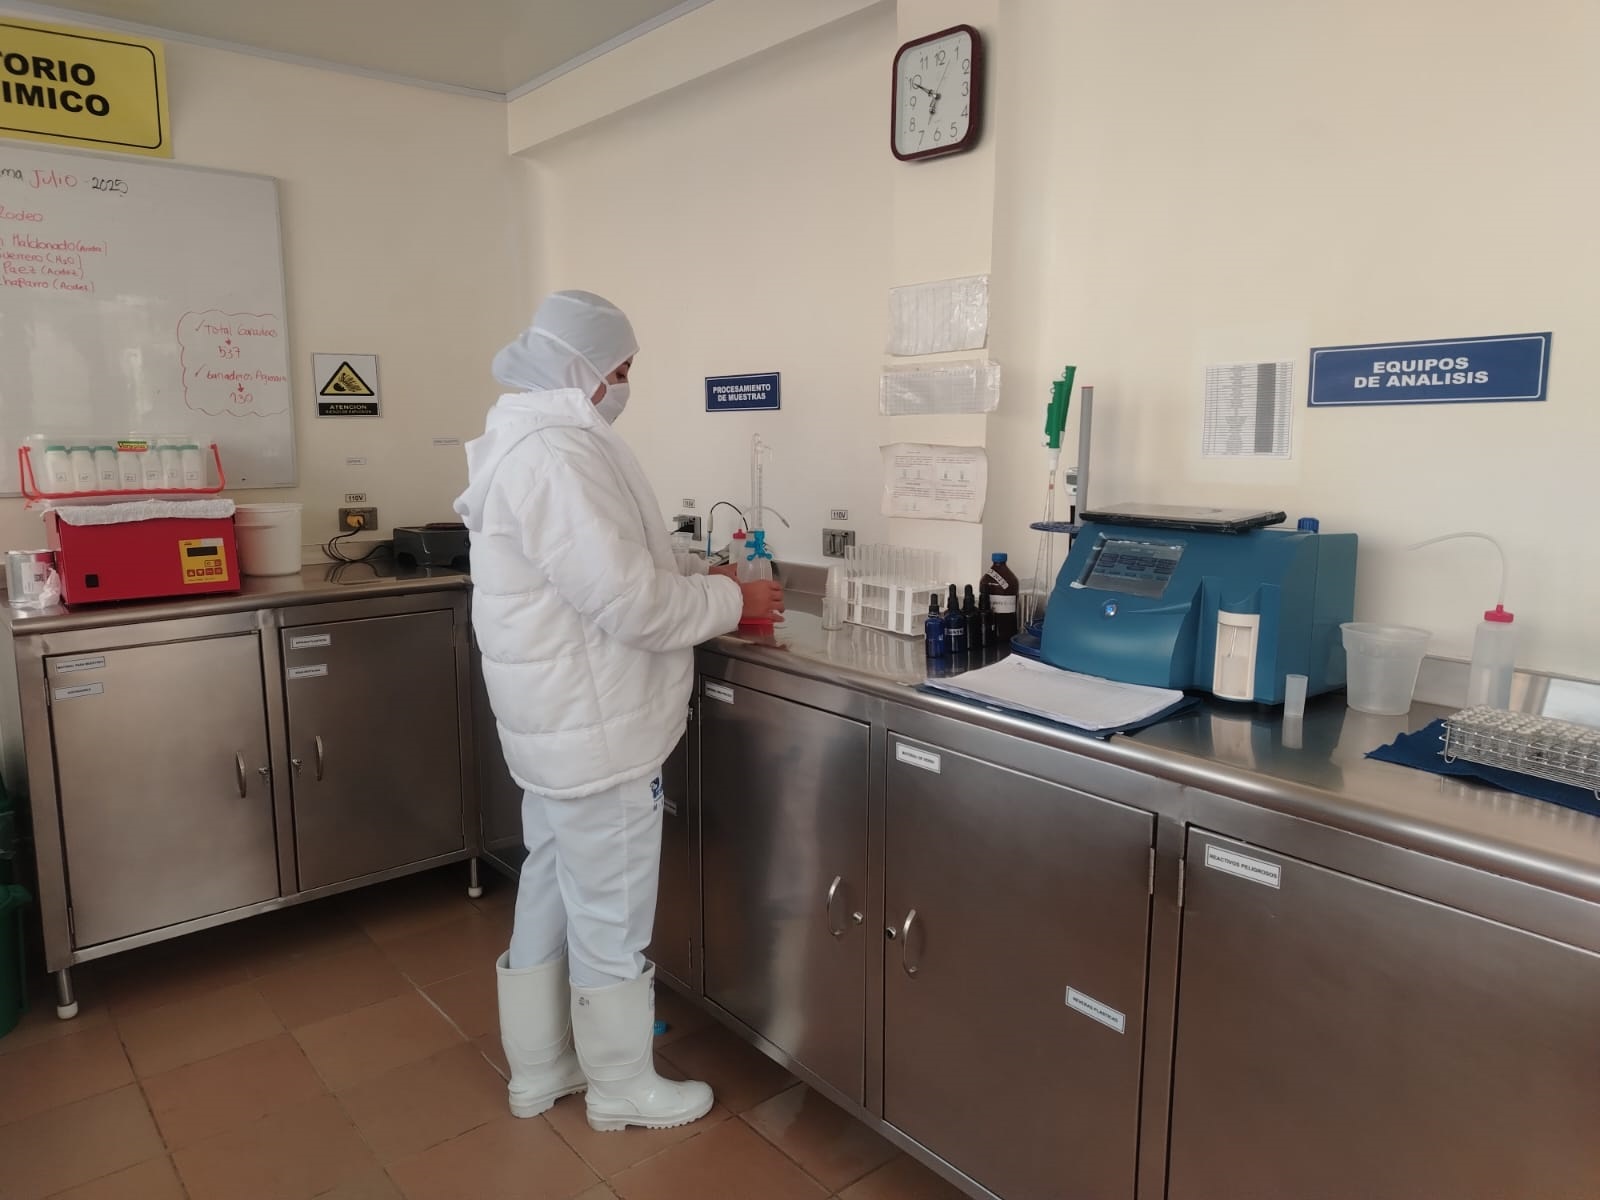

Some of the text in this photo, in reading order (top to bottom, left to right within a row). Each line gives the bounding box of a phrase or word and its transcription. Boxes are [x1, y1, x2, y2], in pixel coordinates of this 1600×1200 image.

[934, 49, 946, 66] 12
[954, 46, 960, 60] 1
[0, 51, 96, 87] ORIO
[920, 56, 929, 70] 11
[962, 58, 970, 75] 2
[909, 75, 922, 90] 10
[961, 81, 969, 97] 3
[2, 80, 110, 117] IMICO
[910, 96, 917, 108] 9
[961, 105, 969, 117] 4
[909, 117, 917, 132] 8
[950, 122, 958, 138] 5
[918, 130, 926, 145] 7
[934, 128, 942, 142] 6
[0, 168, 24, 181] ma
[91, 177, 129, 195] 2025
[1373, 357, 1469, 374] EQUIPOS
[1354, 371, 1489, 388] DE ANALISIS
[712, 383, 771, 394] PROCESAMIENTO
[717, 392, 767, 402] DE MUESTRAS
[1209, 854, 1277, 878] REACTIVOS PELIGROSOS
